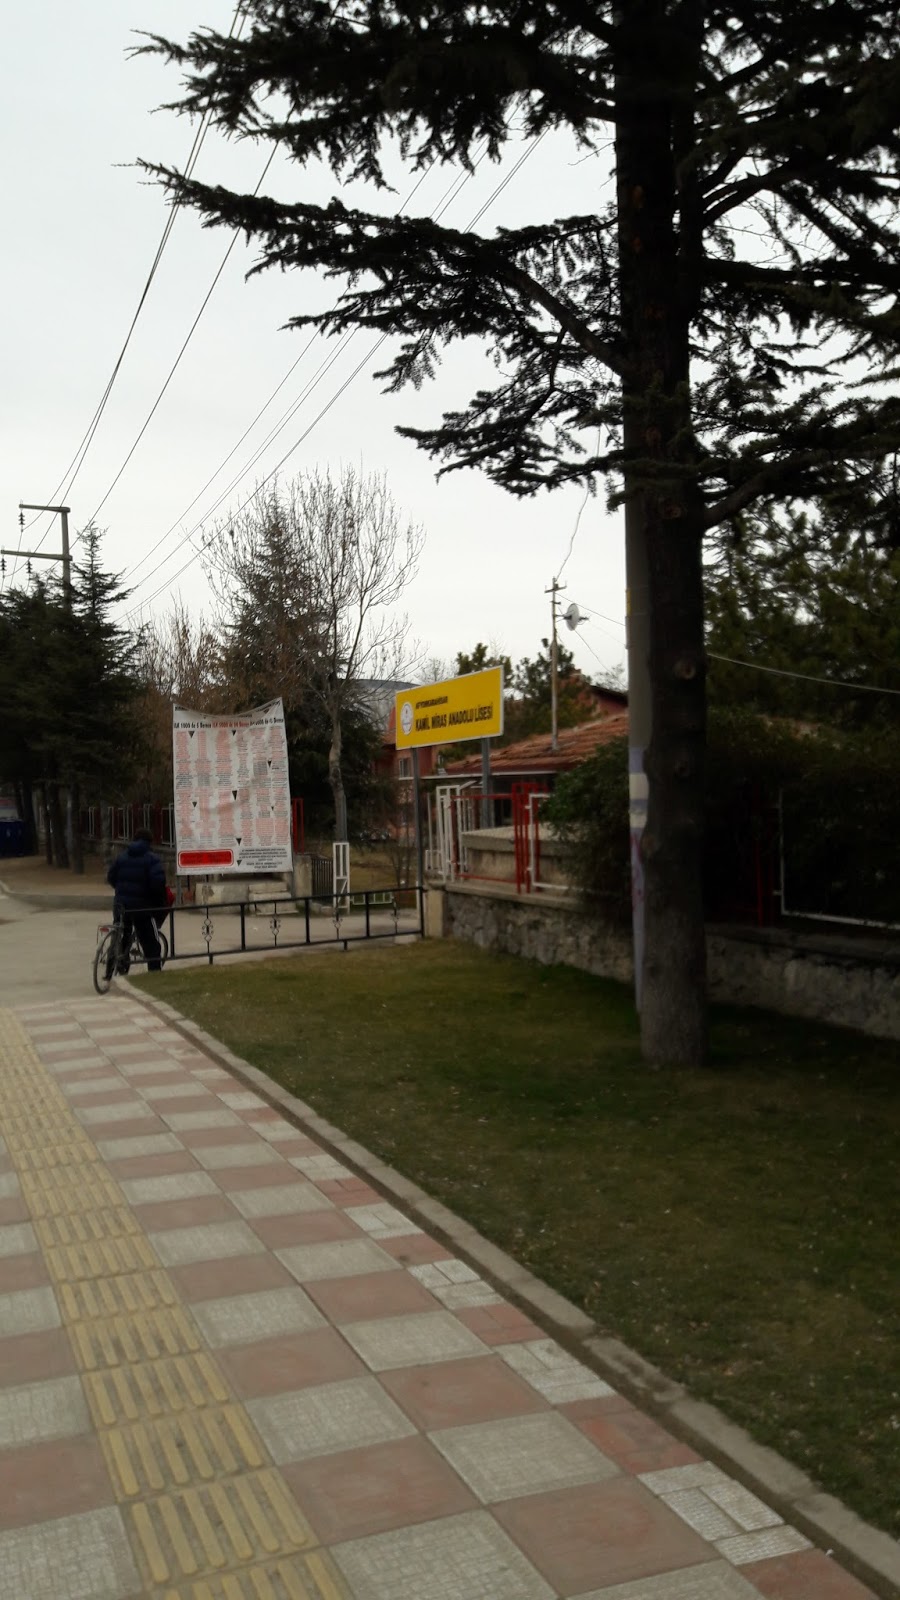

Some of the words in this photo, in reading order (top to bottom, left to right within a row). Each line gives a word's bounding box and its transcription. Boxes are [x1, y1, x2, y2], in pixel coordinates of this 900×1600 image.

[416, 714, 430, 731] KAMİL
[432, 712, 446, 729] MİRAS
[448, 708, 473, 725] ANADOLU
[474, 702, 493, 721] LİSESİ
